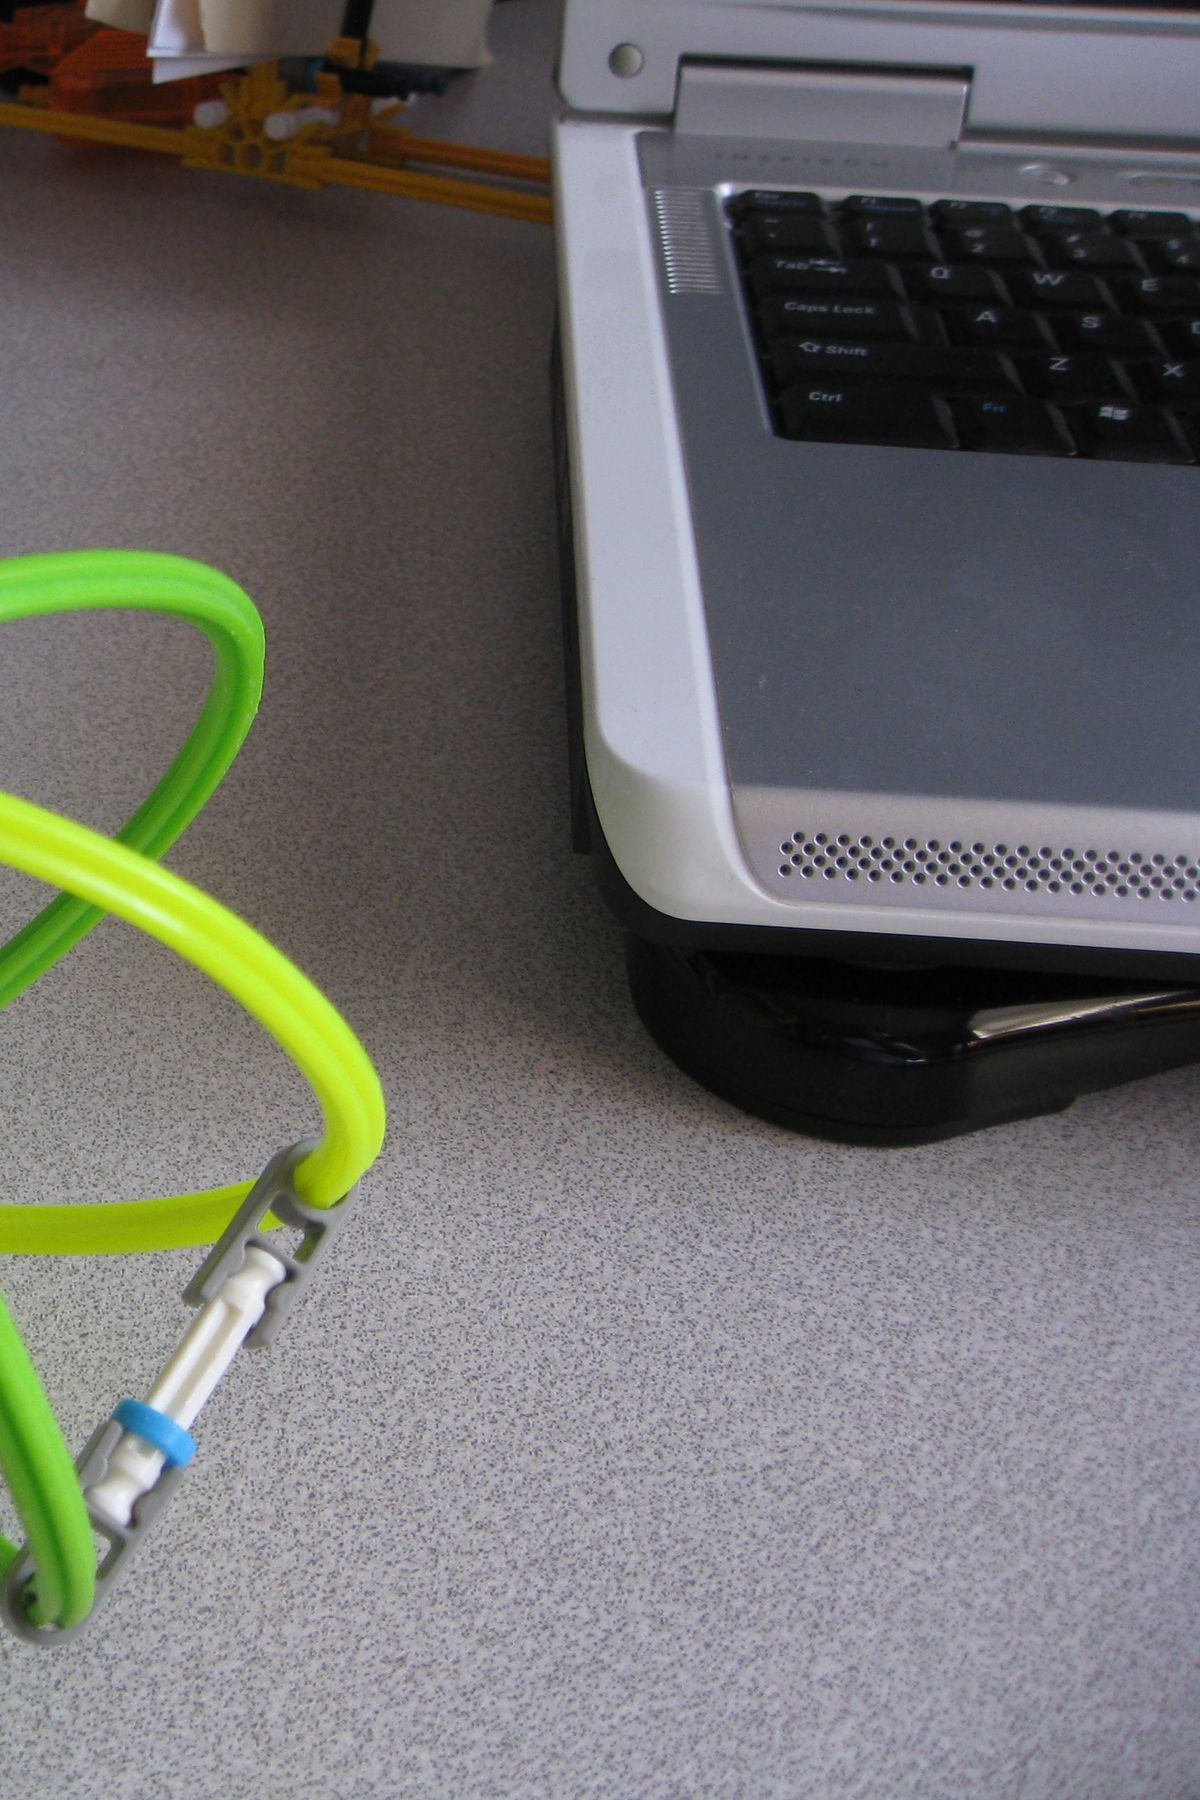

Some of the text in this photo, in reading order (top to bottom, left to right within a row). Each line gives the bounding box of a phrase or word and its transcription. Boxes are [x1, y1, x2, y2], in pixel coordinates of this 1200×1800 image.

[972, 243, 985, 253] 2
[1073, 249, 1086, 258] 3
[776, 261, 808, 270] Tab
[931, 267, 949, 279] Q
[1033, 273, 1065, 286] W
[1142, 279, 1158, 291] E
[784, 302, 875, 314] Caps Lock
[976, 311, 996, 323] A
[1081, 316, 1100, 328] S
[826, 345, 868, 356] Shift
[1050, 358, 1068, 371] Z
[1163, 363, 1184, 377] X
[809, 391, 842, 402] Ctrl
